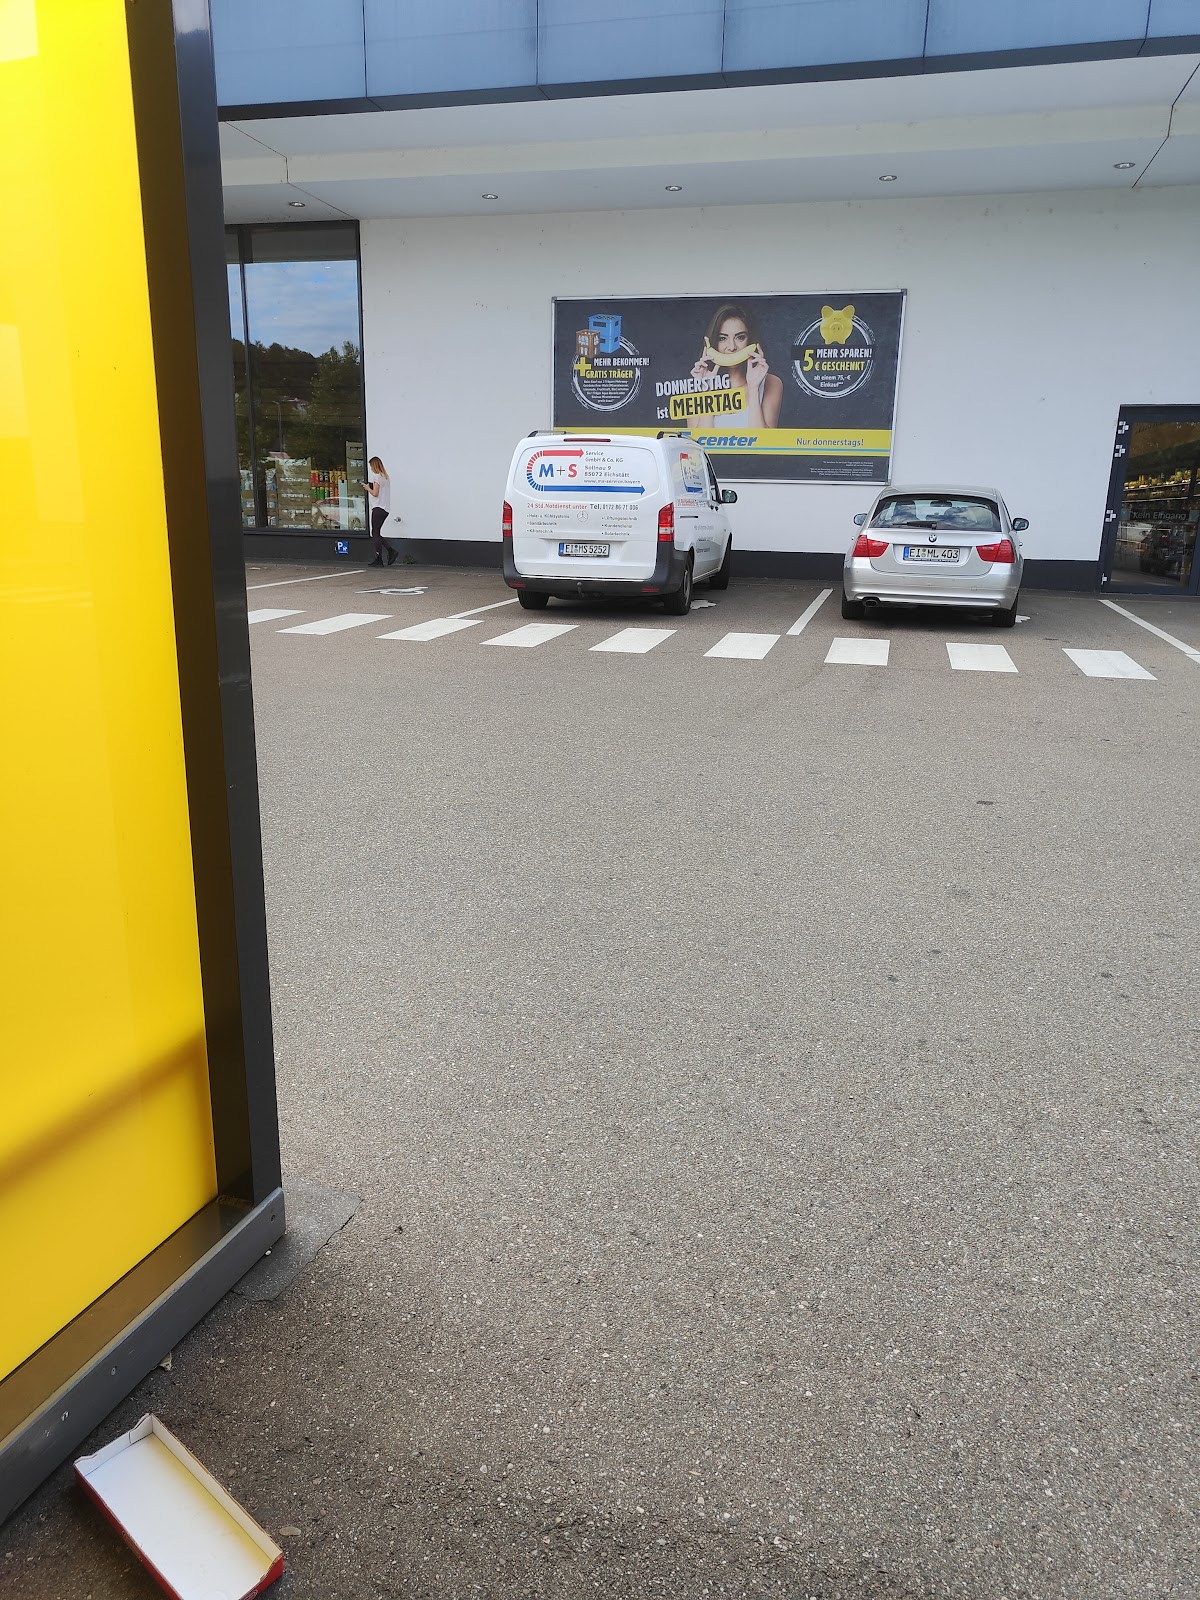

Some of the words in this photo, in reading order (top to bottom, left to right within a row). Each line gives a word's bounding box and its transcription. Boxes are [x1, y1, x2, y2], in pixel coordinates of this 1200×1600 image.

[816, 348, 838, 358] MEHR
[840, 348, 872, 358] SPAREN!
[594, 358, 612, 366] MEHR
[612, 358, 650, 366] BEKOMMEN!
[803, 349, 814, 371] 5
[815, 362, 820, 371] €
[822, 361, 865, 371] GESCHENKT
[586, 370, 608, 378] GRATIS
[610, 368, 633, 378] TRÄGER
[655, 374, 730, 397] DONNERSTAG
[656, 406, 669, 419] ist
[673, 392, 742, 417] MEHRTAG
[698, 436, 757, 446] center
[813, 438, 864, 447] donnerstags!
[1153, 512, 1186, 520] Eingang
[338, 542, 343, 550] P
[565, 544, 574, 553] EI
[579, 545, 588, 554] MS
[589, 546, 607, 554] 5252
[910, 548, 921, 557] EI
[927, 549, 939, 558] ML
[941, 549, 958, 558] 403
